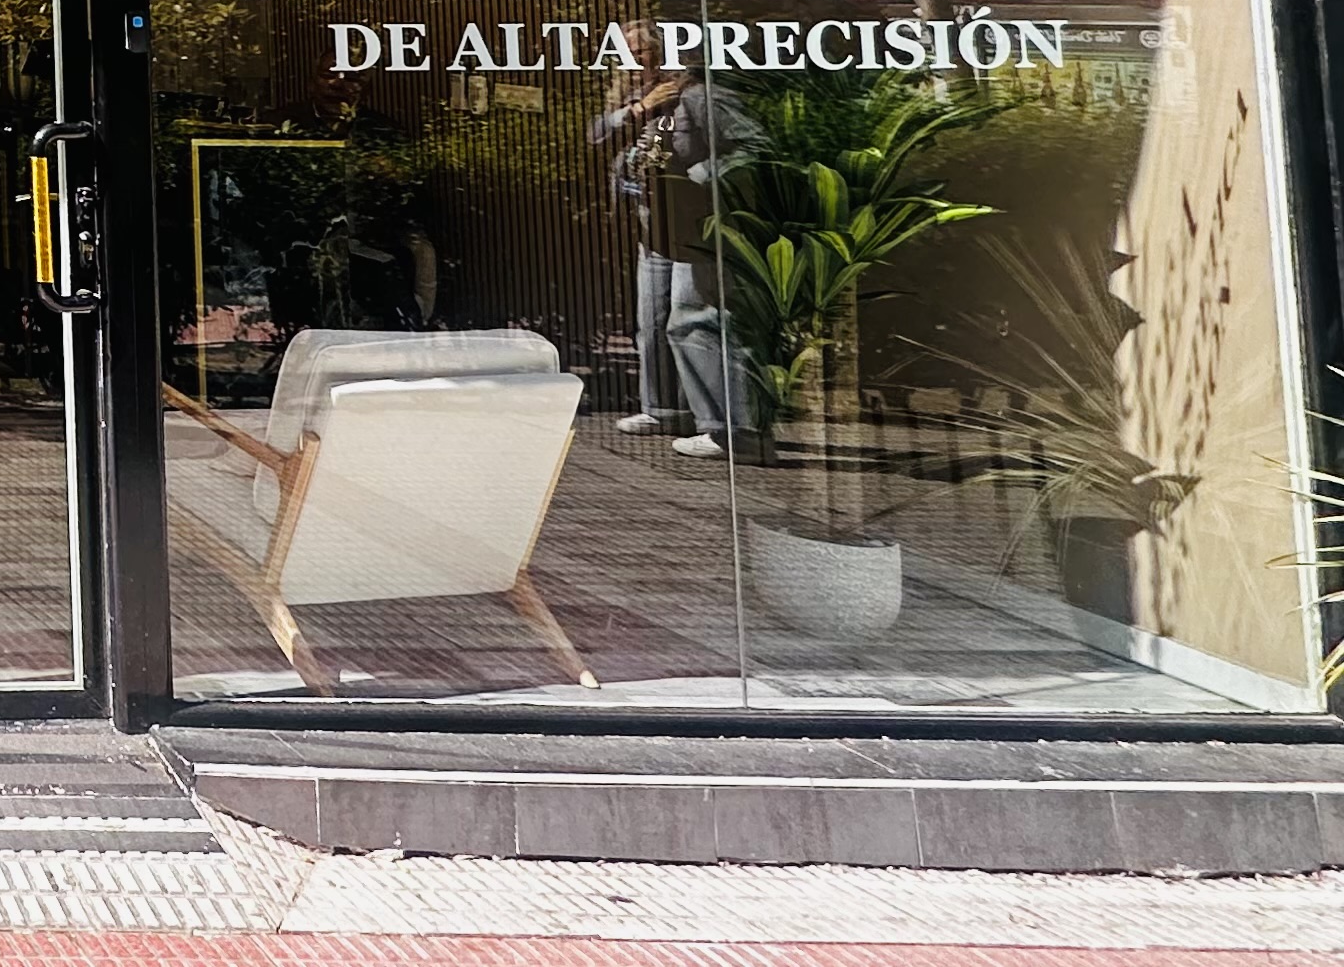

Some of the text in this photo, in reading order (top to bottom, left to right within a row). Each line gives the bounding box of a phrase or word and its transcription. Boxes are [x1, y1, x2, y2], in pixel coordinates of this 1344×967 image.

[329, 7, 1069, 72] DE ALTA PRECISIÓN
